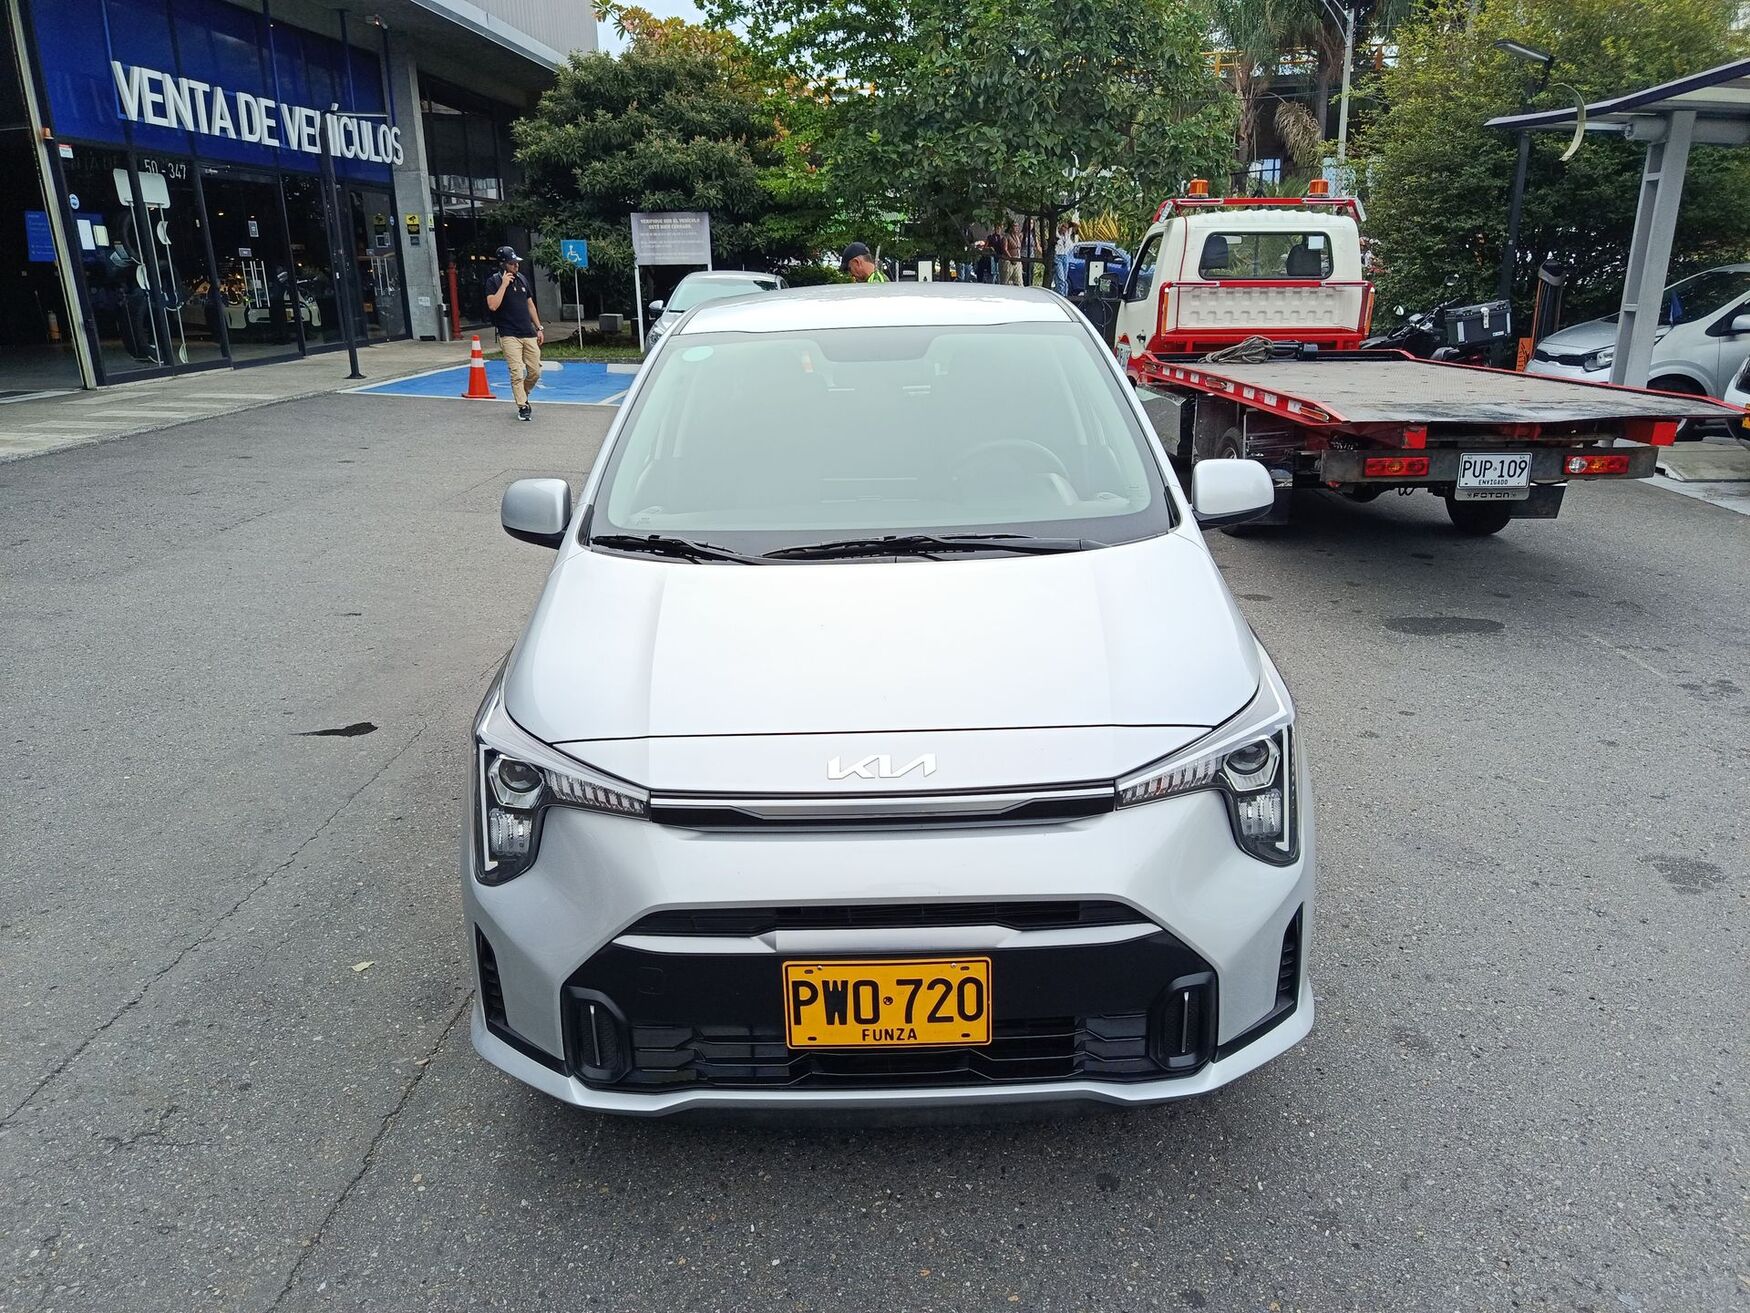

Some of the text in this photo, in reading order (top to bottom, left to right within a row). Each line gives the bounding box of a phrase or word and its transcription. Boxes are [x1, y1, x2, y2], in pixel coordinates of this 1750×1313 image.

[111, 60, 237, 139] VENTA
[236, 92, 280, 147] DE
[144, 159, 159, 174] 50
[168, 162, 186, 180] 347
[861, 1028, 918, 1042] FUNZA
